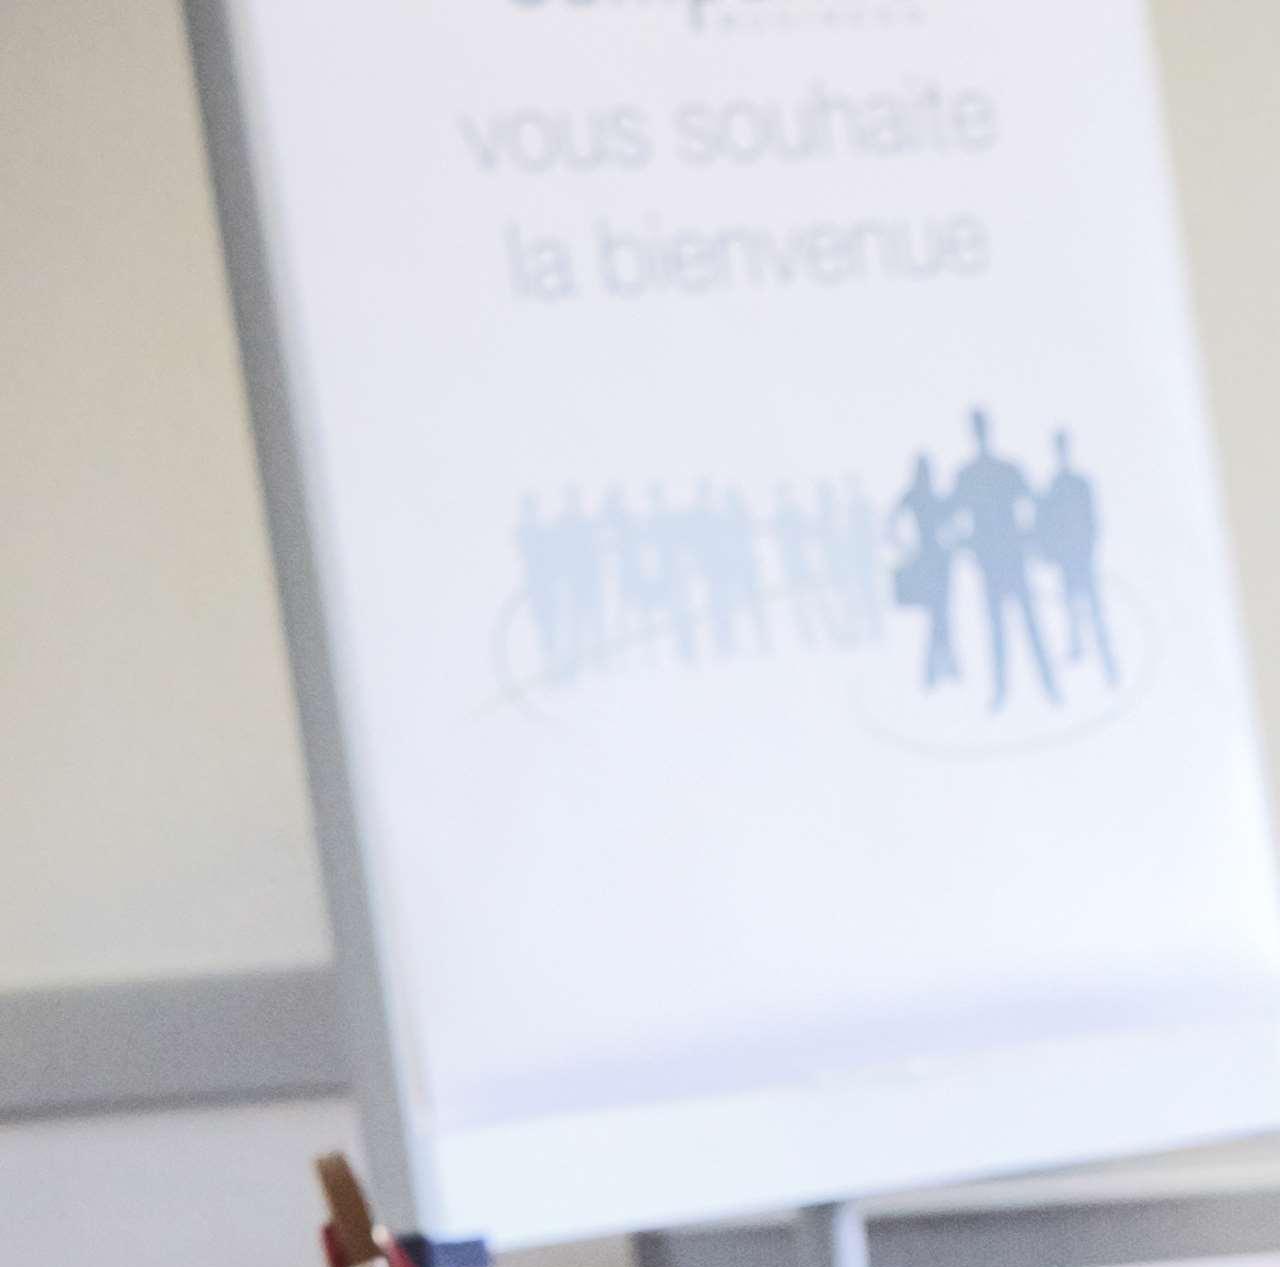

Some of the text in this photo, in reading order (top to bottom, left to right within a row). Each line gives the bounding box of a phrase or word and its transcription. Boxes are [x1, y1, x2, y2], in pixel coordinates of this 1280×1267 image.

[455, 78, 999, 174] vous souhaite
[503, 209, 992, 301] la bienvenue
